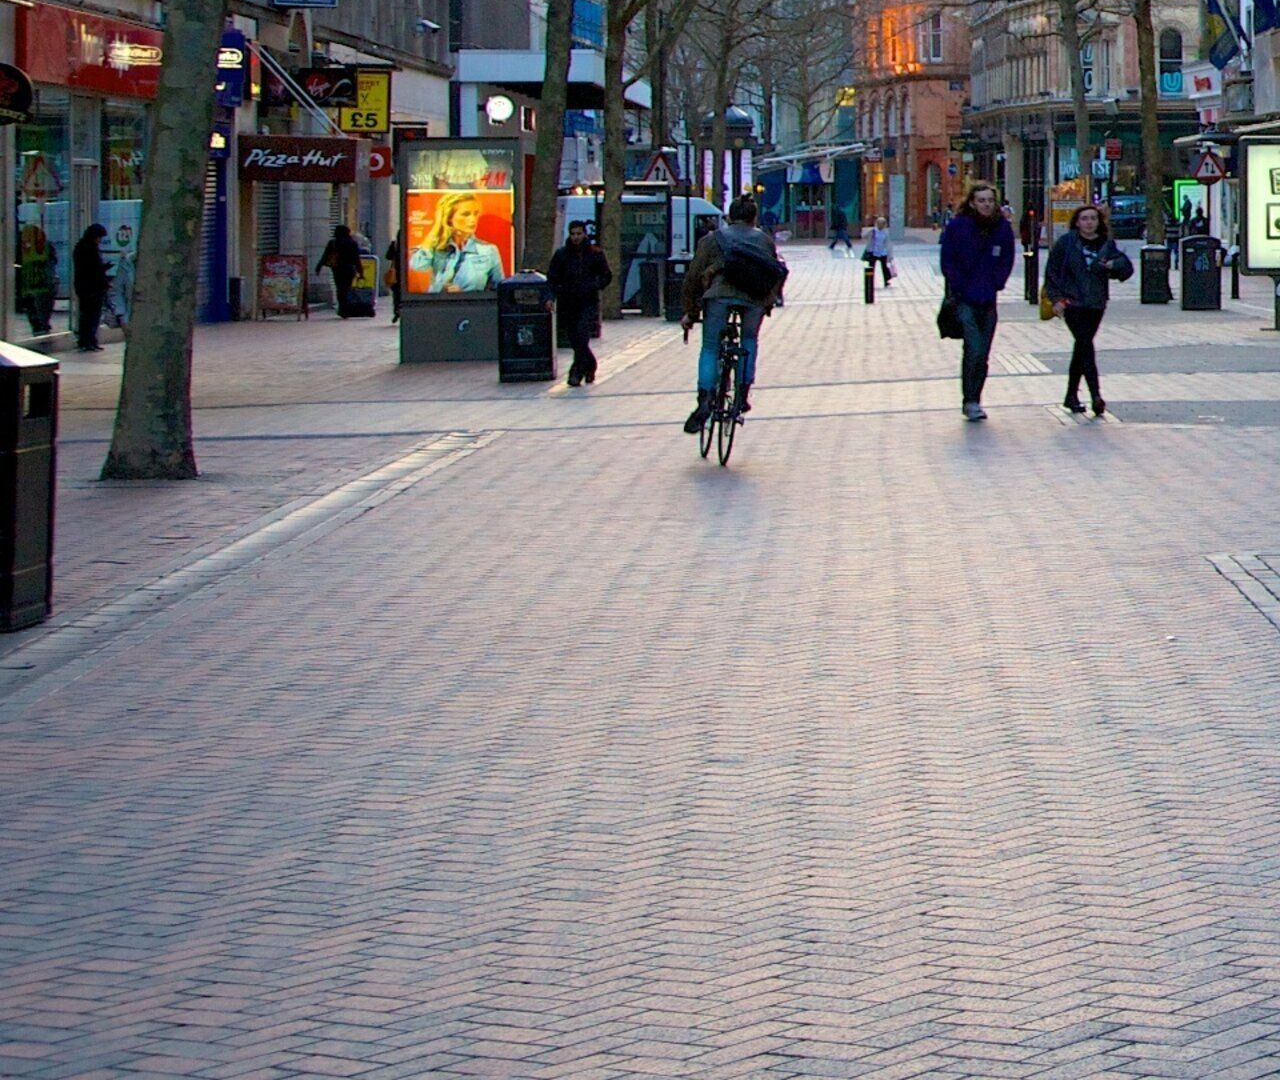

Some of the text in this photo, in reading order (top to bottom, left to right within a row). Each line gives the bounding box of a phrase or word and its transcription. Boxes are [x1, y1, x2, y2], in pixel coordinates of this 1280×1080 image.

[351, 112, 378, 128] £5
[244, 149, 348, 168] Pizza Hut
